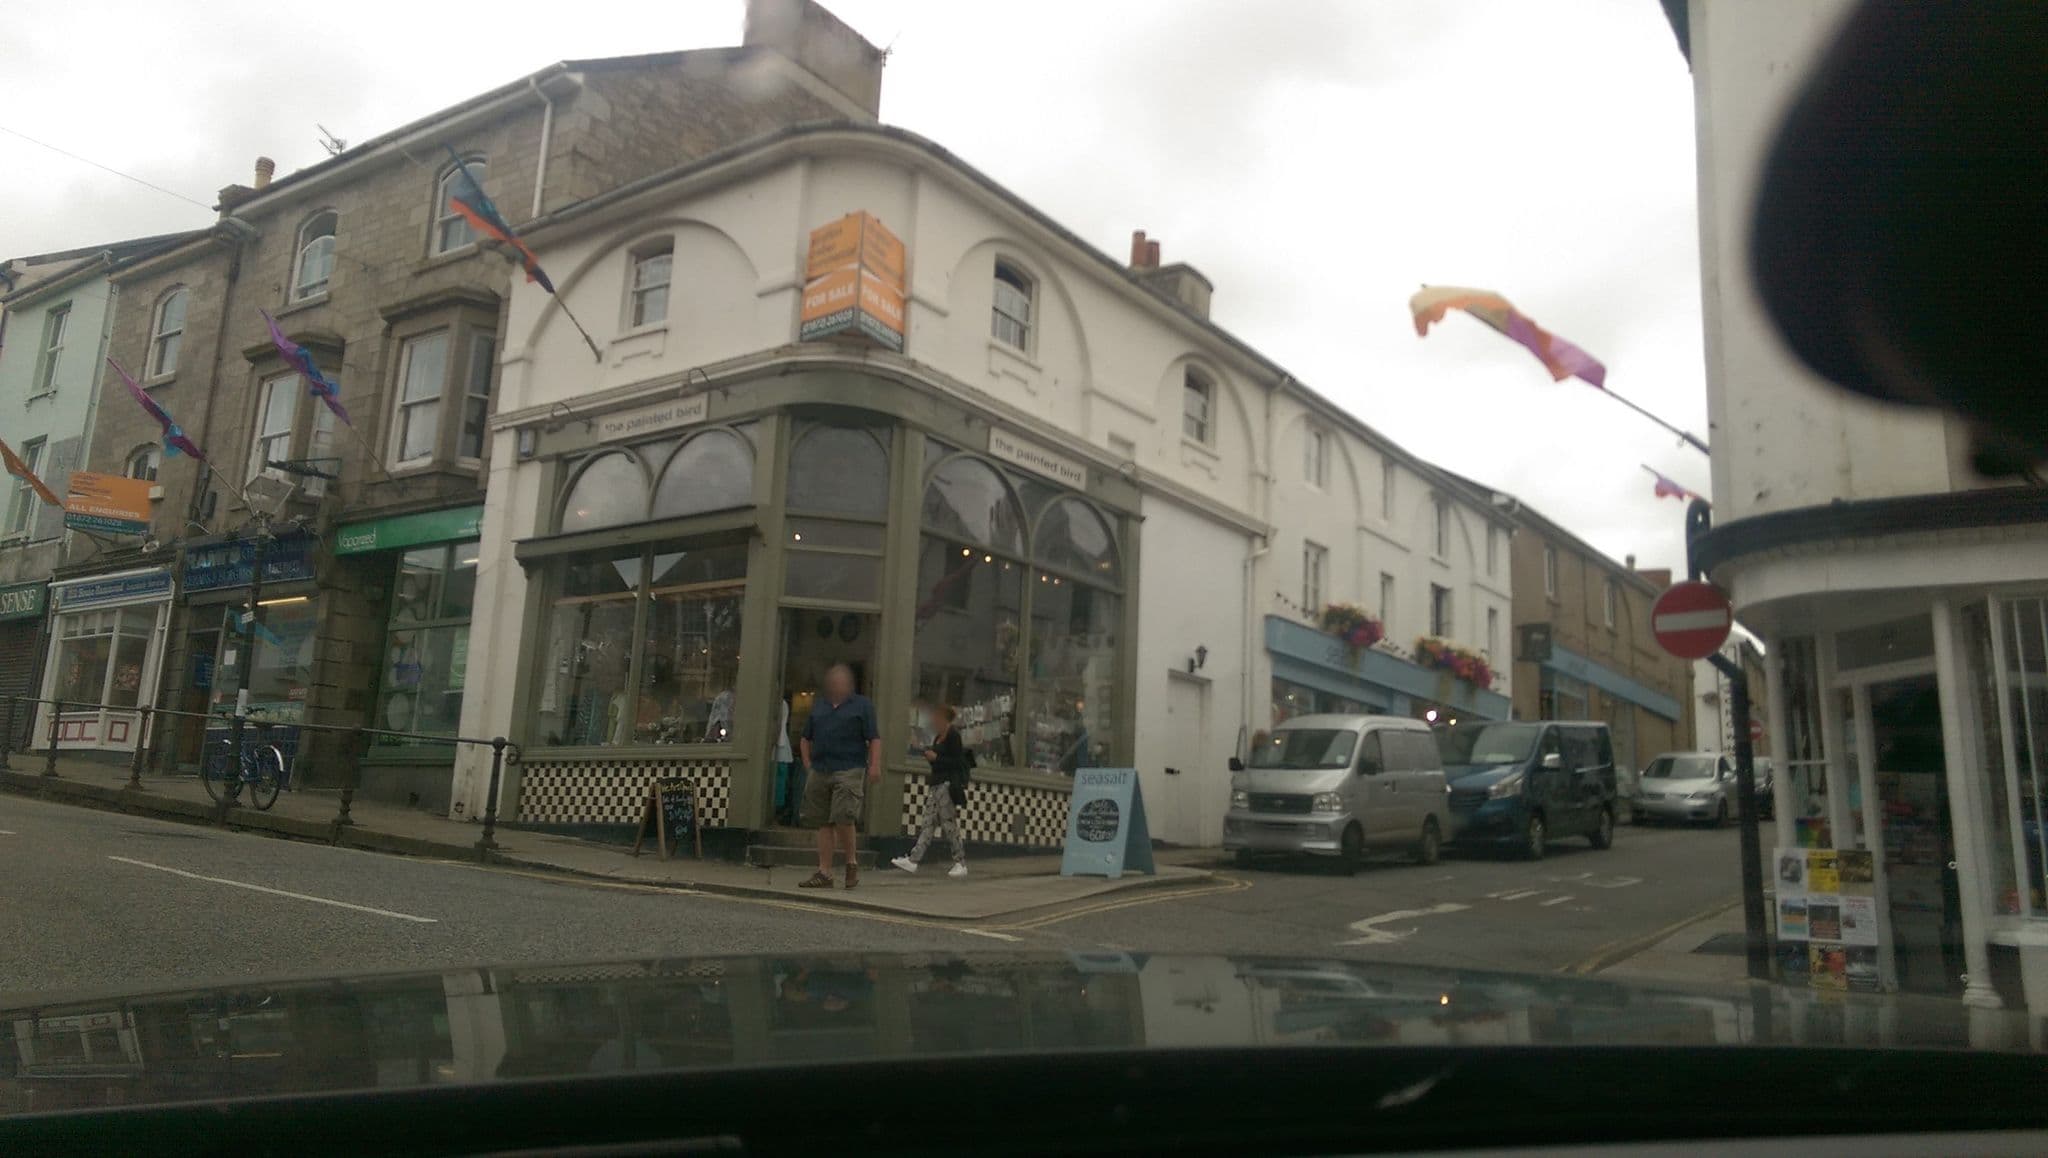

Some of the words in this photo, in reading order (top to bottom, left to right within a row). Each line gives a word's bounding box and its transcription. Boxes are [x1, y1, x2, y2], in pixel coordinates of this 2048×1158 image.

[806, 291, 827, 309] FOR
[828, 283, 856, 300] SALE
[626, 408, 673, 432] painted
[676, 400, 701, 418] bird
[995, 438, 1014, 453] the
[1016, 448, 1058, 472] painted
[1060, 464, 1081, 482] bird
[68, 503, 87, 513] ALL
[0, 588, 37, 615] SENSE
[1081, 771, 1128, 785] seasalt
